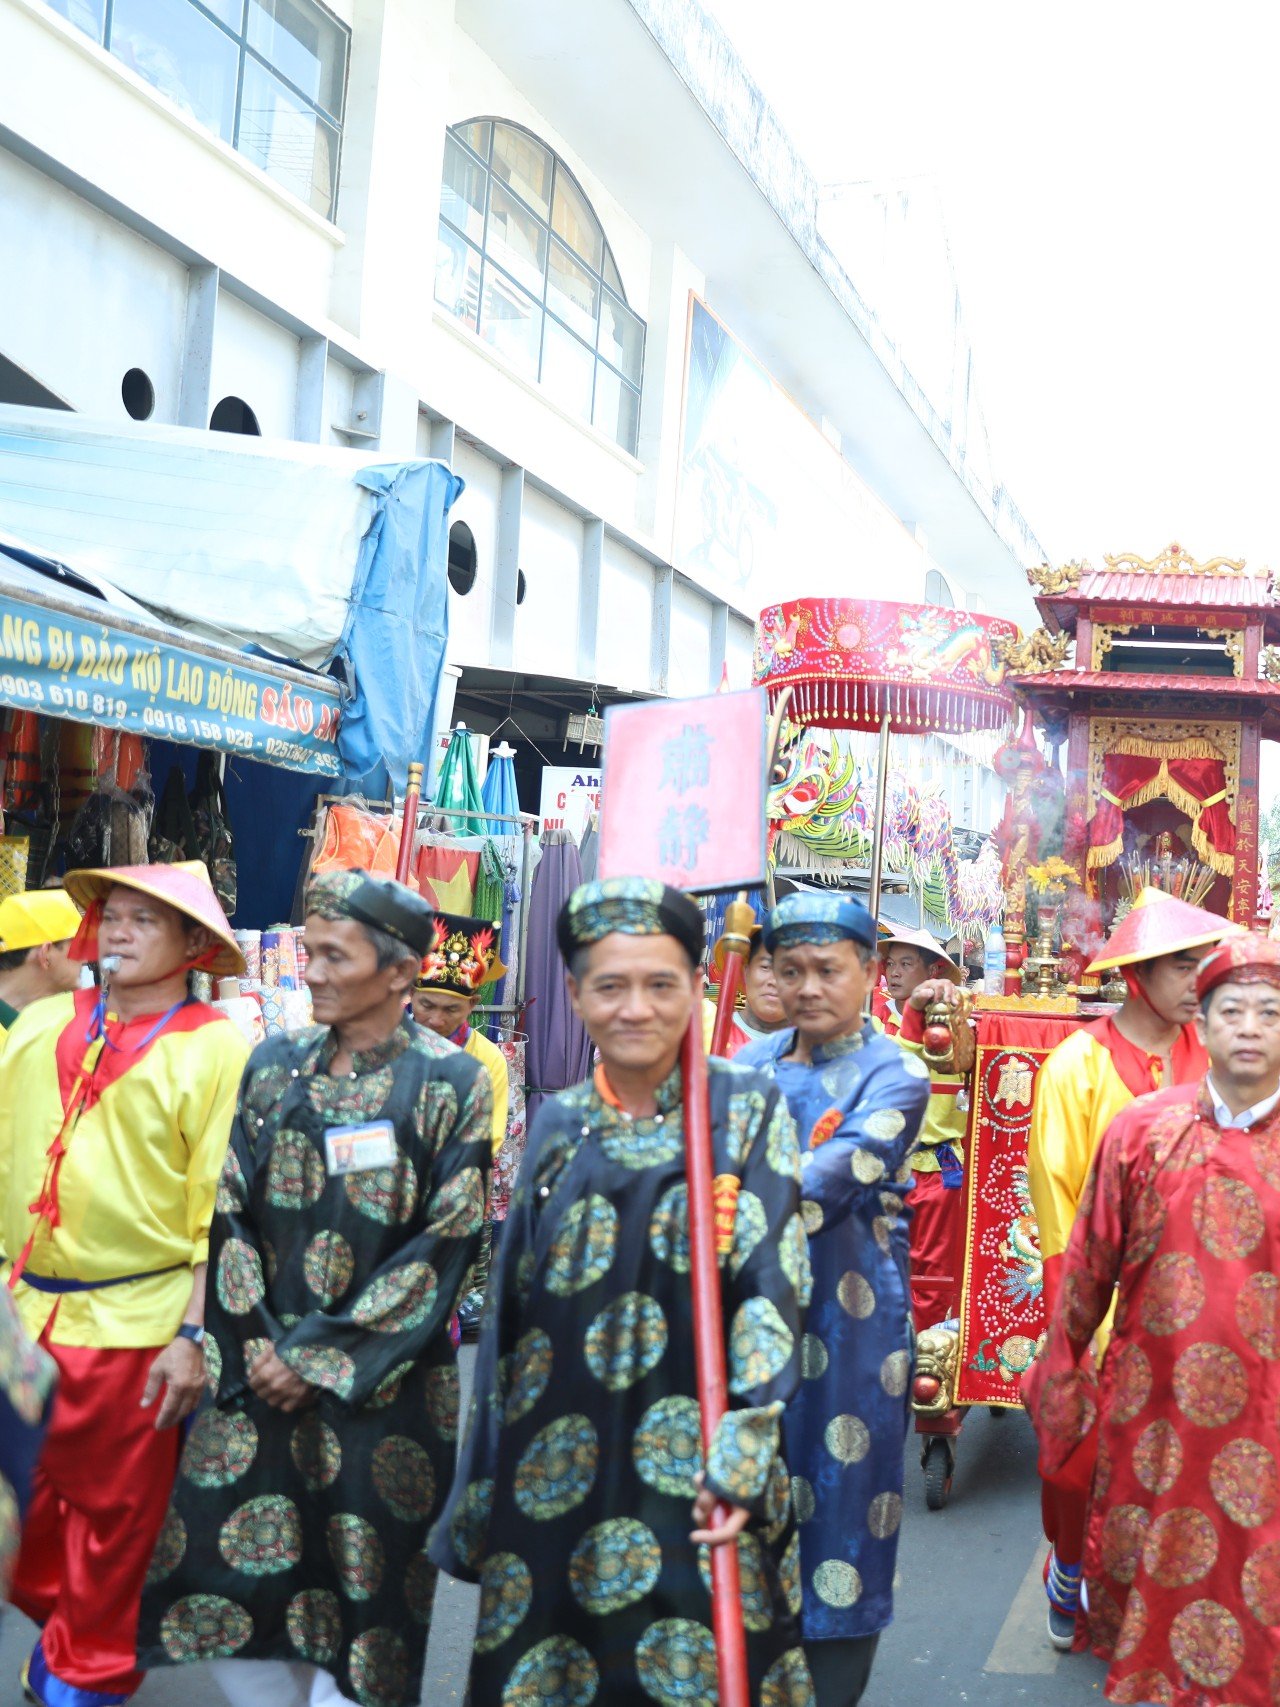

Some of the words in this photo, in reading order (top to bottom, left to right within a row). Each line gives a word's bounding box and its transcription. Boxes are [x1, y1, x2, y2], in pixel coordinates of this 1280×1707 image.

[0, 613, 42, 666] NG
[48, 626, 75, 683] BỊ
[77, 627, 129, 686] BẢO
[132, 645, 161, 703] HỘ
[166, 658, 204, 706] LAO
[207, 668, 258, 722] ĐỘNG
[0, 674, 45, 701] 903
[50, 685, 88, 711] 610
[93, 694, 128, 720] 819
[143, 707, 187, 734] 0918
[190, 718, 223, 741] 158
[225, 726, 254, 749] 026
